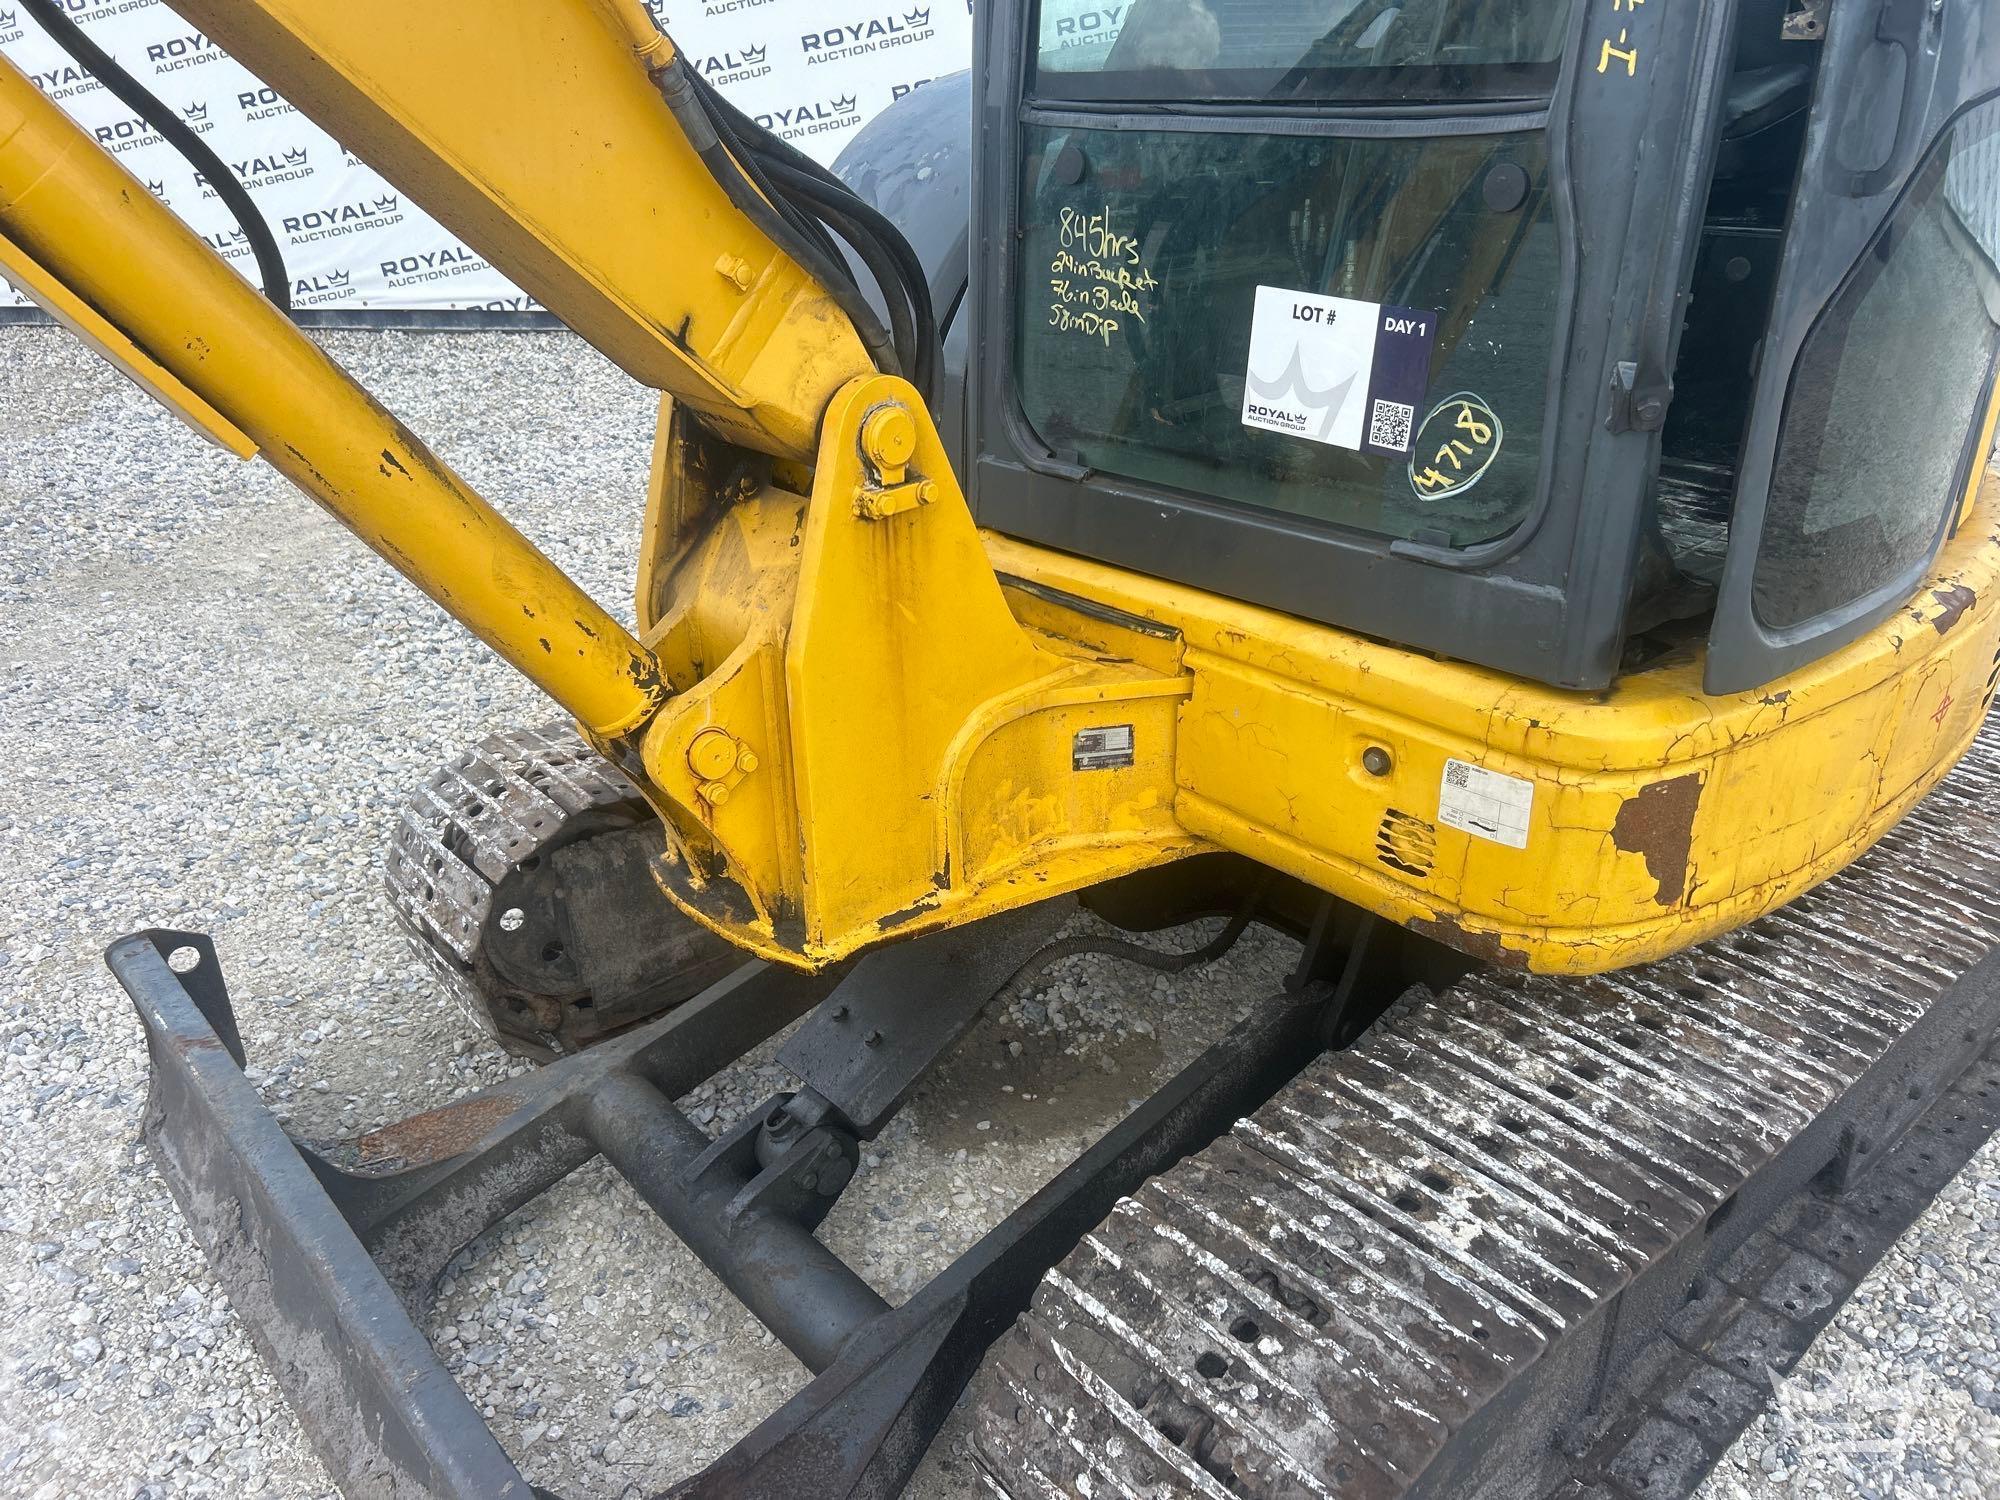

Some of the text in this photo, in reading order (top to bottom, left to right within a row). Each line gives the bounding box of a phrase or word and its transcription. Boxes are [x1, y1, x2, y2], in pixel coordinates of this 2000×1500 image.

[70, 6, 117, 25] CTION
[1056, 6, 1122, 37] ROY
[801, 16, 904, 52] ROYAL
[1061, 29, 1120, 49] AUCTIO
[146, 33, 213, 62] ROY
[807, 29, 935, 65] AUCTION GROUP
[155, 51, 218, 75] AUCTION
[717, 66, 772, 86] GROUP
[754, 102, 832, 130] OYAL
[807, 115, 862, 134] GROUP
[94, 118, 150, 143] ROY
[264, 167, 314, 186] GROUP
[282, 203, 376, 233] ROYAL
[291, 214, 404, 245] AUCTION GROUP
[380, 247, 473, 277] ROYAL
[388, 260, 490, 288] AUCTION GROU
[308, 288, 356, 305] GROUP
[1292, 304, 1337, 326] LOT #
[1384, 317, 1427, 337] DAY 1
[1248, 404, 1294, 422] ROYAL
[1248, 415, 1306, 431] AUCTION GROUP
